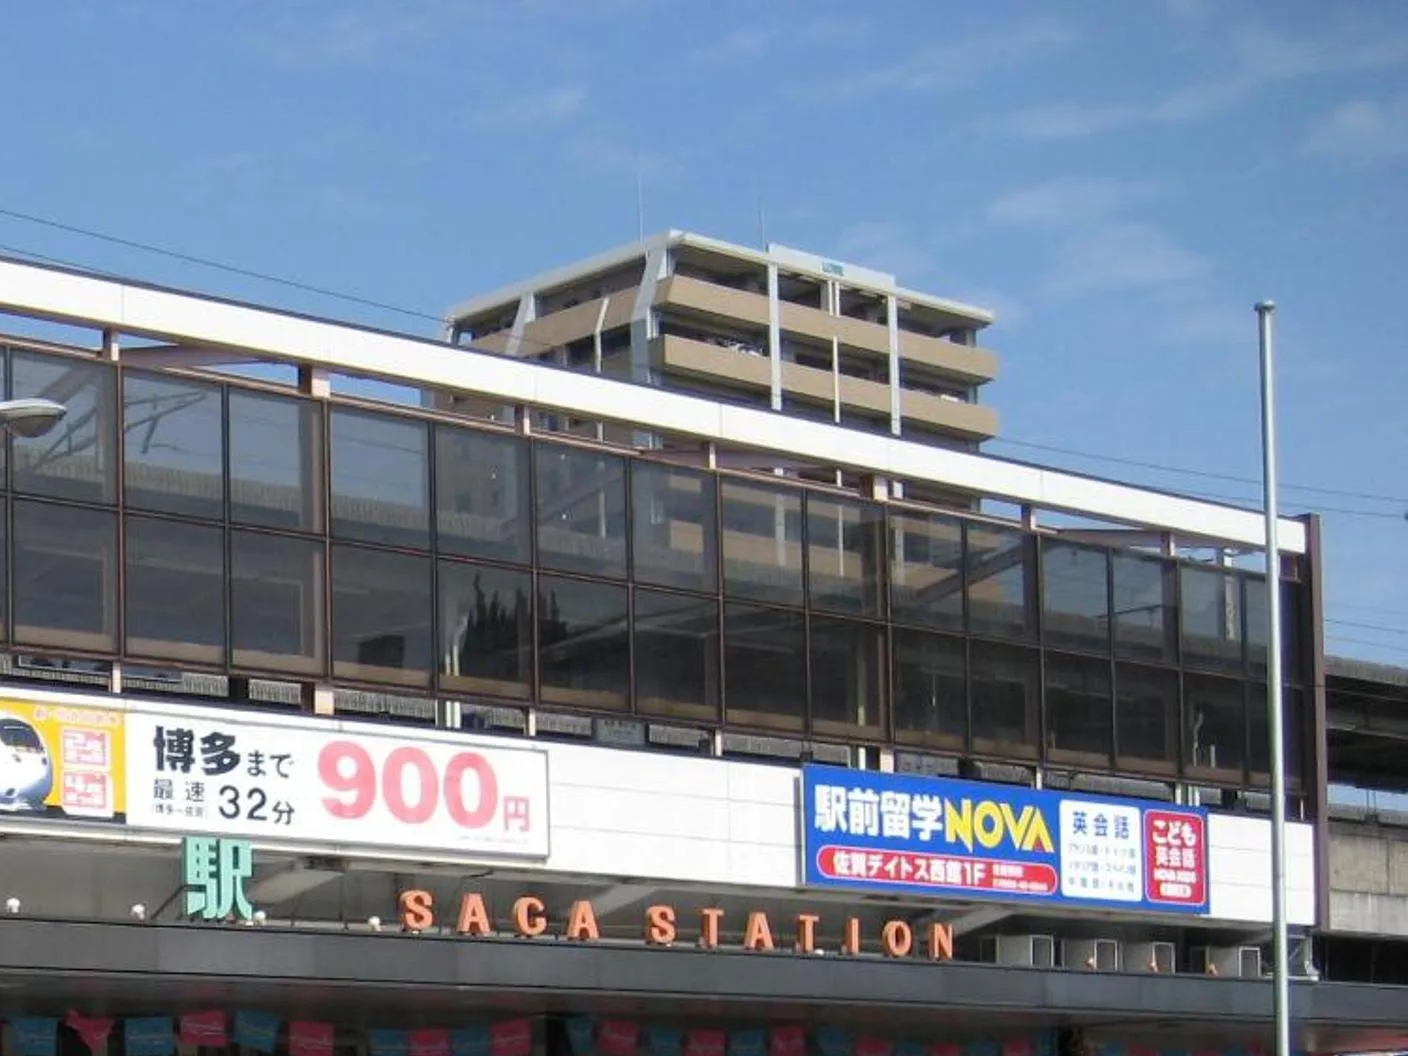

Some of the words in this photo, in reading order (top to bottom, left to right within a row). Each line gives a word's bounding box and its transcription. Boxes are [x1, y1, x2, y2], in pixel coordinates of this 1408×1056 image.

[153, 726, 295, 778] 博多まで
[218, 785, 295, 825] 32分
[317, 740, 531, 832] 900円
[814, 784, 943, 841] 駅前留学
[945, 797, 1055, 853] NOVA
[1072, 810, 1129, 839] 英会話
[1152, 820, 1197, 847] こども
[399, 889, 600, 940] SAGA
[645, 905, 954, 960] STATION
